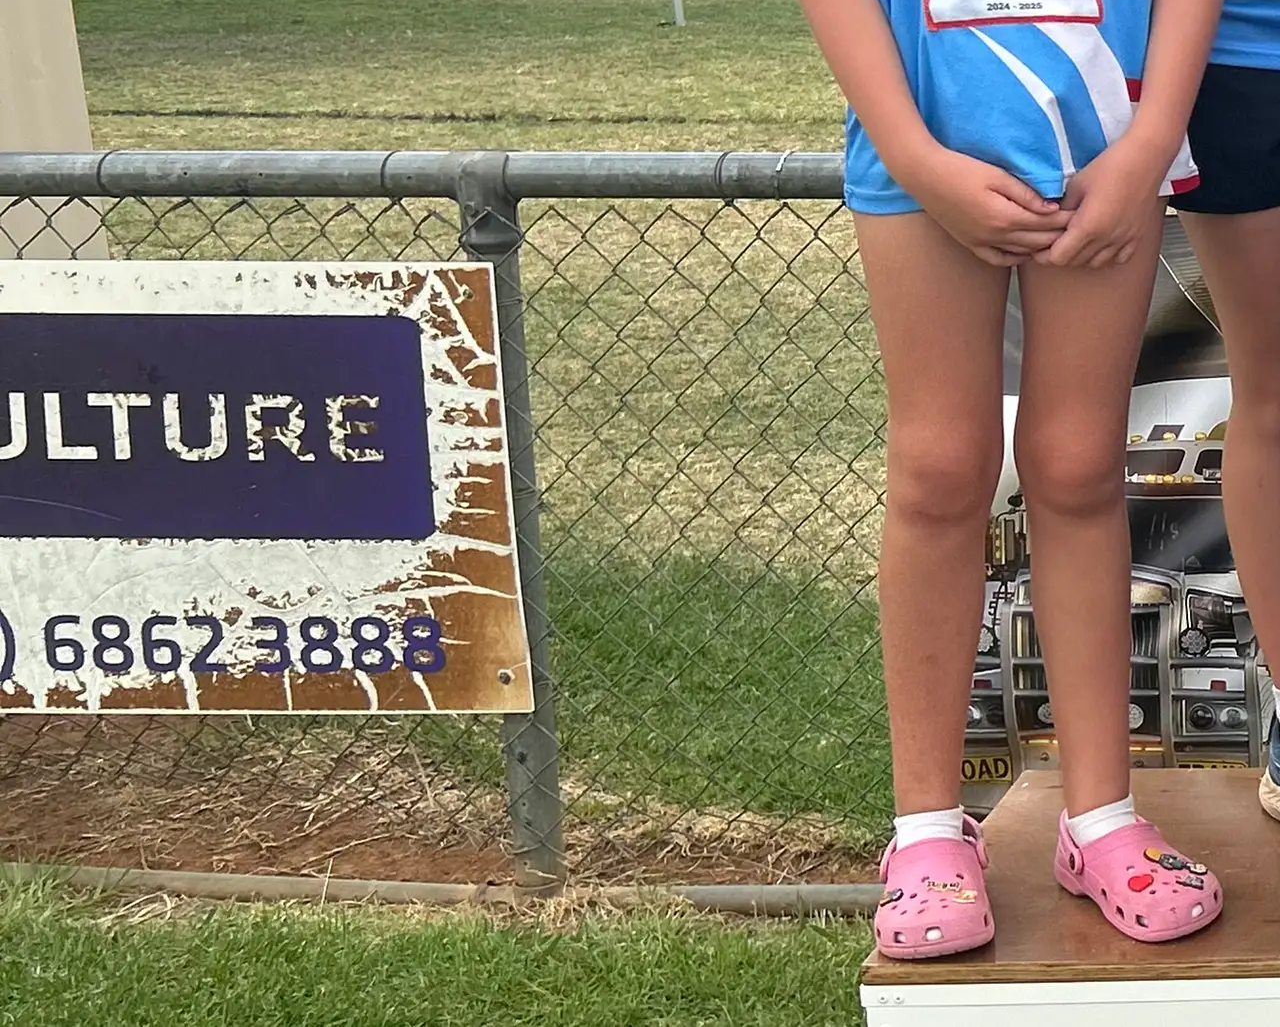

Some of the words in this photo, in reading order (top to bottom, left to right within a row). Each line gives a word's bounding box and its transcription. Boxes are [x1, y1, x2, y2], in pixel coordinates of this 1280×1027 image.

[987, 3, 1010, 11] 2024
[1019, 2, 1043, 10] 2025
[44, 615, 228, 672] 6862
[250, 616, 447, 673] 3888
[961, 758, 1009, 781] OAD
